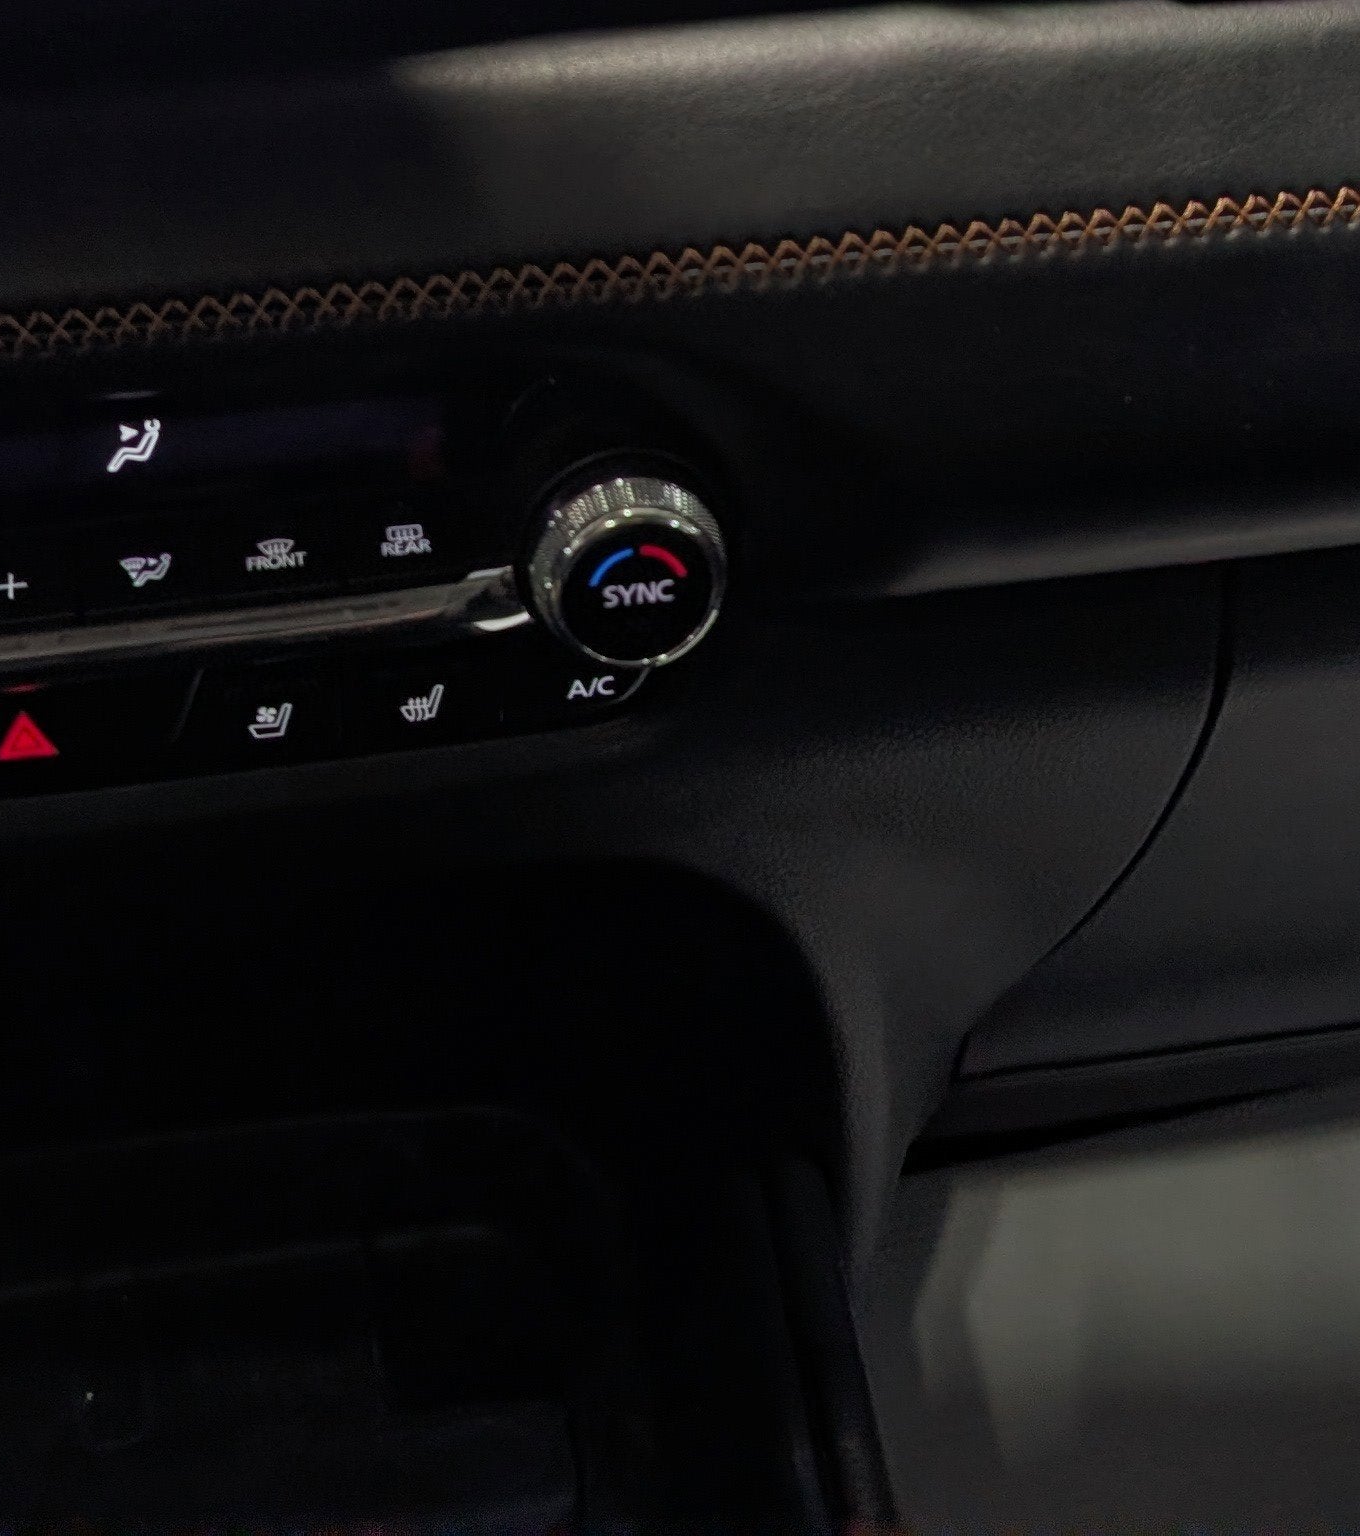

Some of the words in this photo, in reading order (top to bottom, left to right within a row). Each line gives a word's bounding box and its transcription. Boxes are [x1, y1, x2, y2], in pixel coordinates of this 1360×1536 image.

[381, 538, 431, 555] REAR
[246, 550, 307, 571] FRONT
[603, 579, 675, 607] SYNC
[566, 675, 615, 699] A/C
